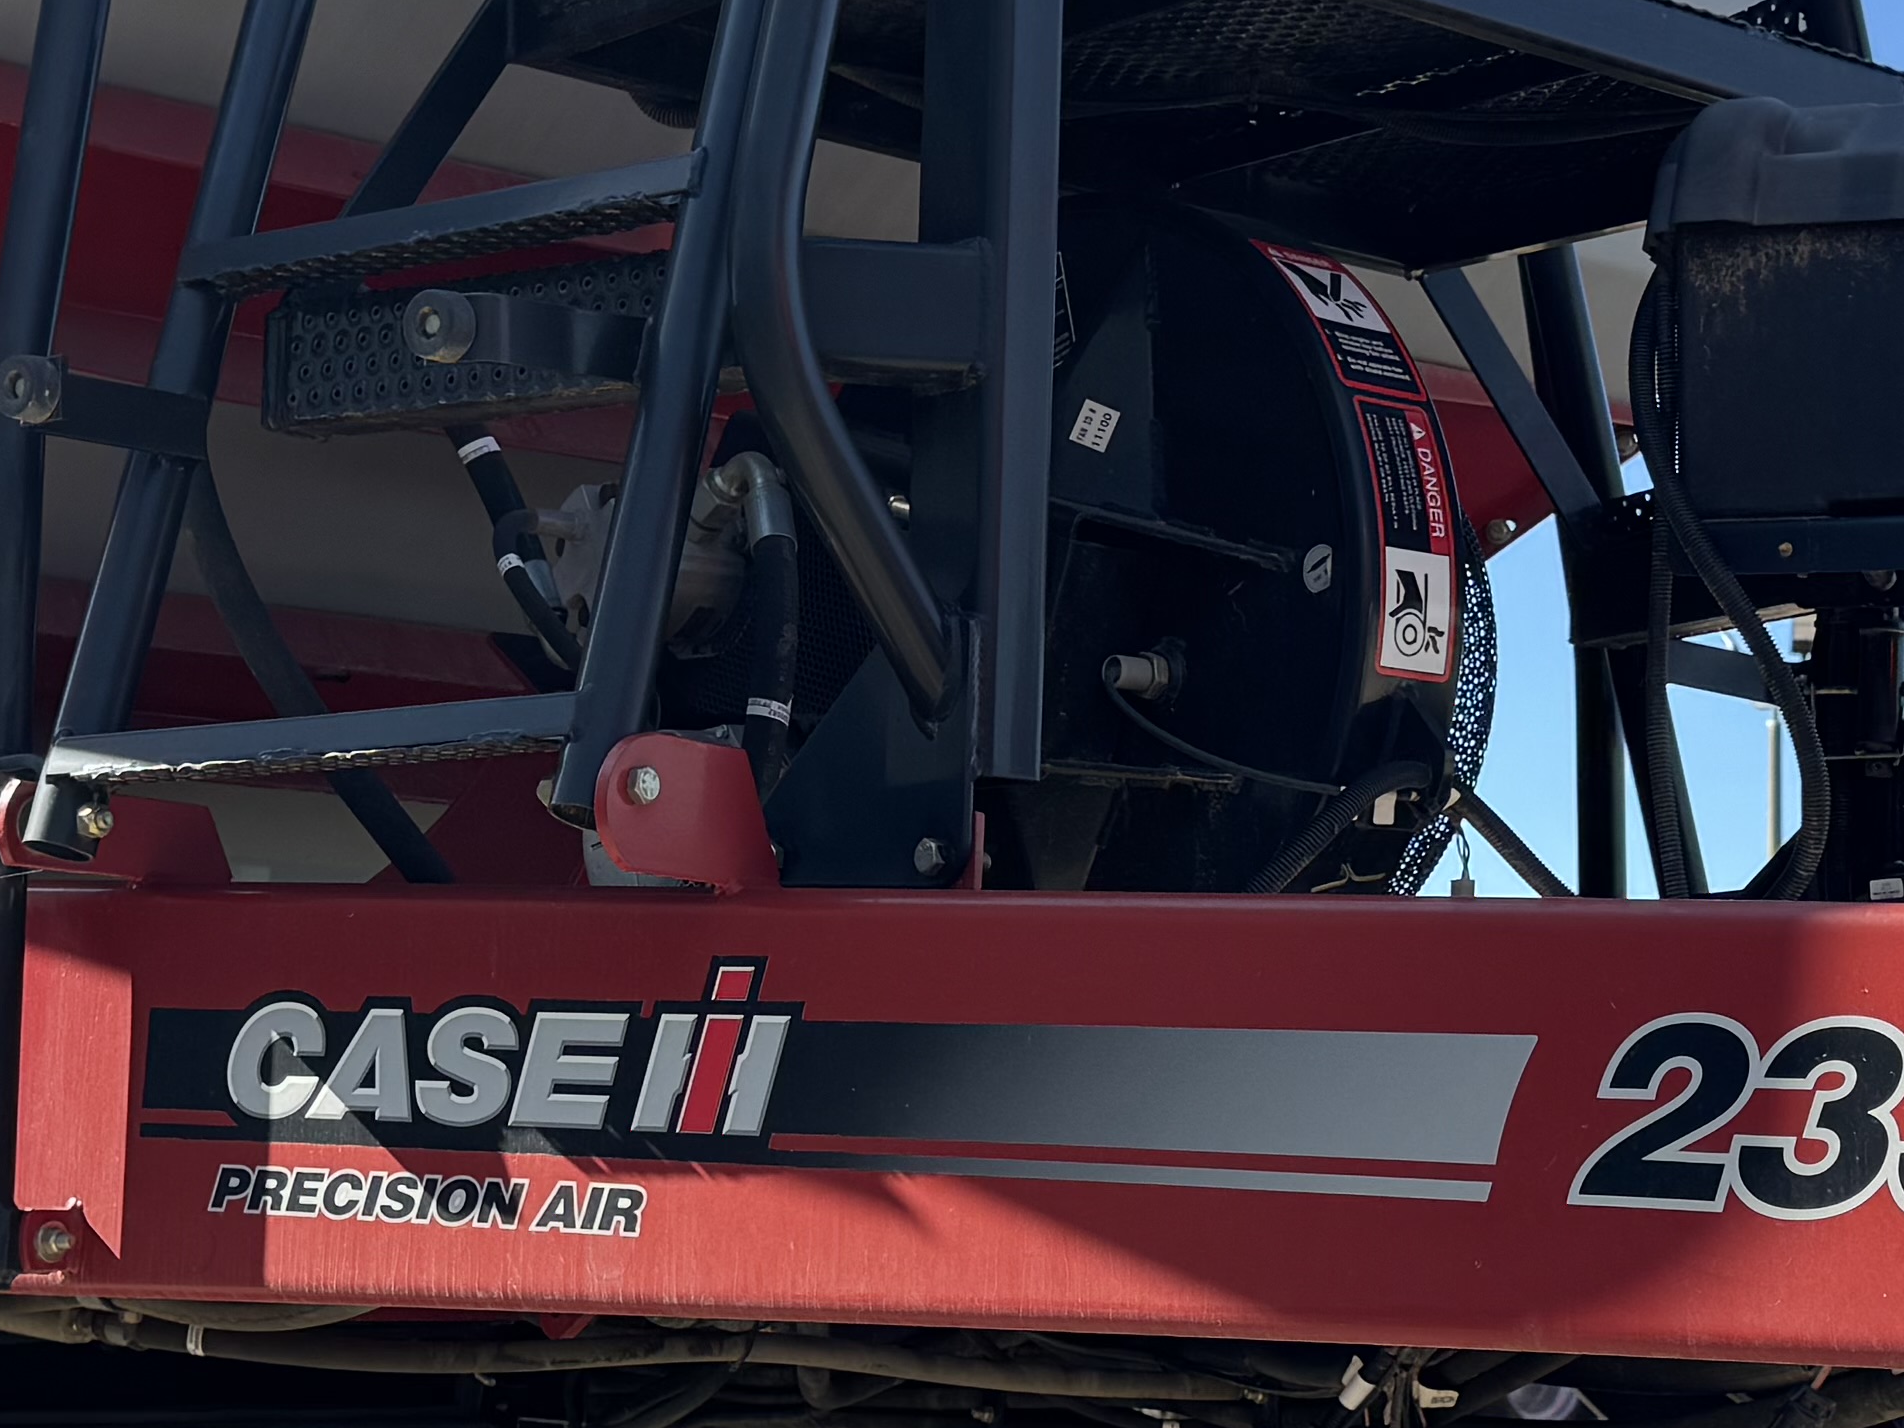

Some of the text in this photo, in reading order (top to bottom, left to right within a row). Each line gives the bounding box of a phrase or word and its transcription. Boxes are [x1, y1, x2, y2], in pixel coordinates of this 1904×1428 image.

[1091, 412, 1113, 447] 11100
[1417, 447, 1446, 538] DANGER
[227, 1000, 630, 1130] CASE
[208, 1164, 648, 1238] PRECISION AIR
